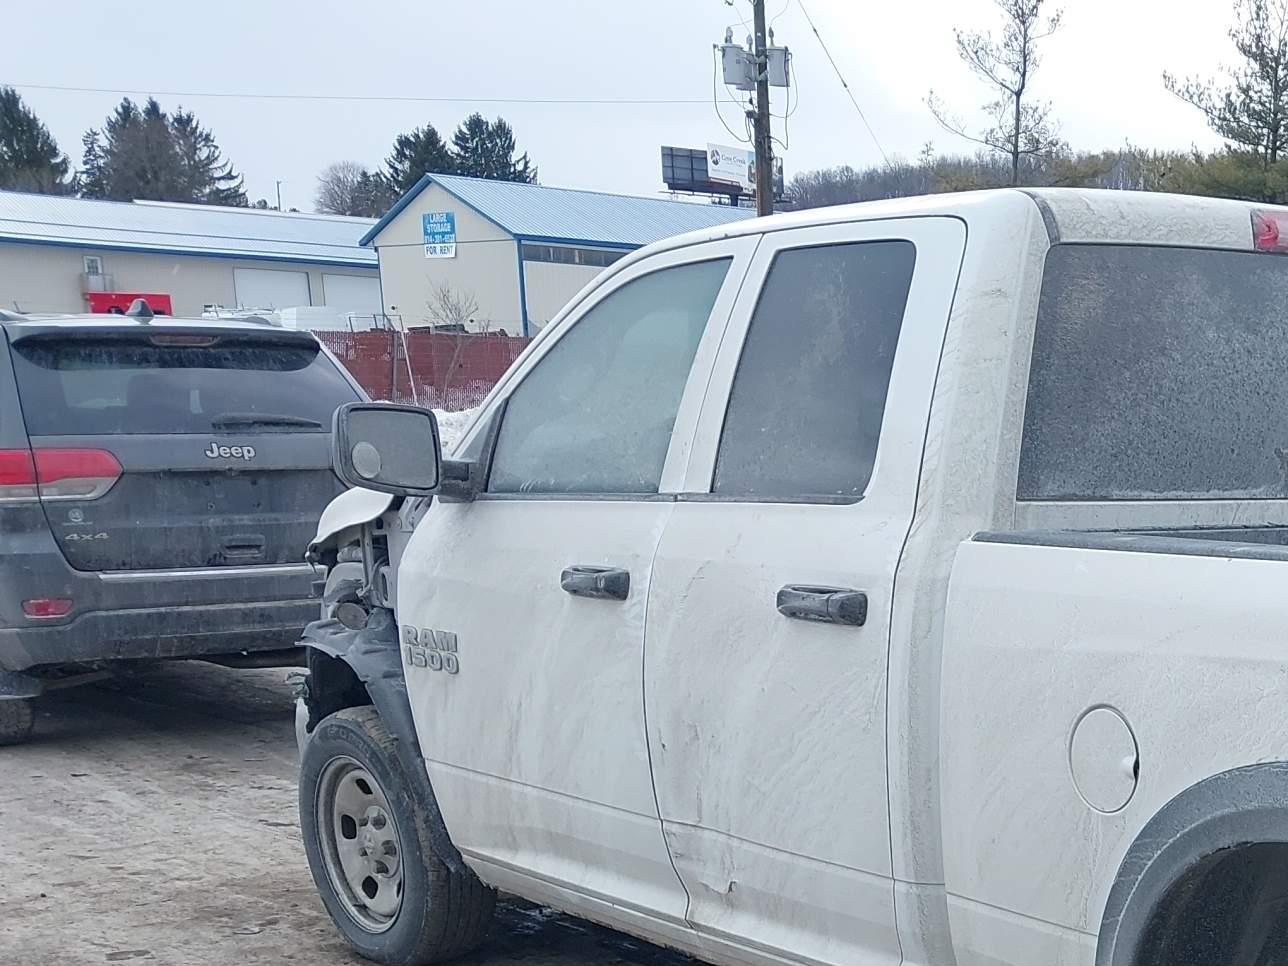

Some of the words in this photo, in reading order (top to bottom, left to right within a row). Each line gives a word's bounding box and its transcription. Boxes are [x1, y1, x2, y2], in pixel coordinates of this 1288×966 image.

[429, 213, 448, 222] LARGE
[427, 223, 451, 233] STORAGE
[426, 245, 438, 255] FOR
[440, 245, 454, 255] RENT
[205, 442, 256, 461] Jeep
[65, 532, 109, 541] 4x4
[401, 624, 458, 653] RAM
[405, 645, 460, 675] 1500
